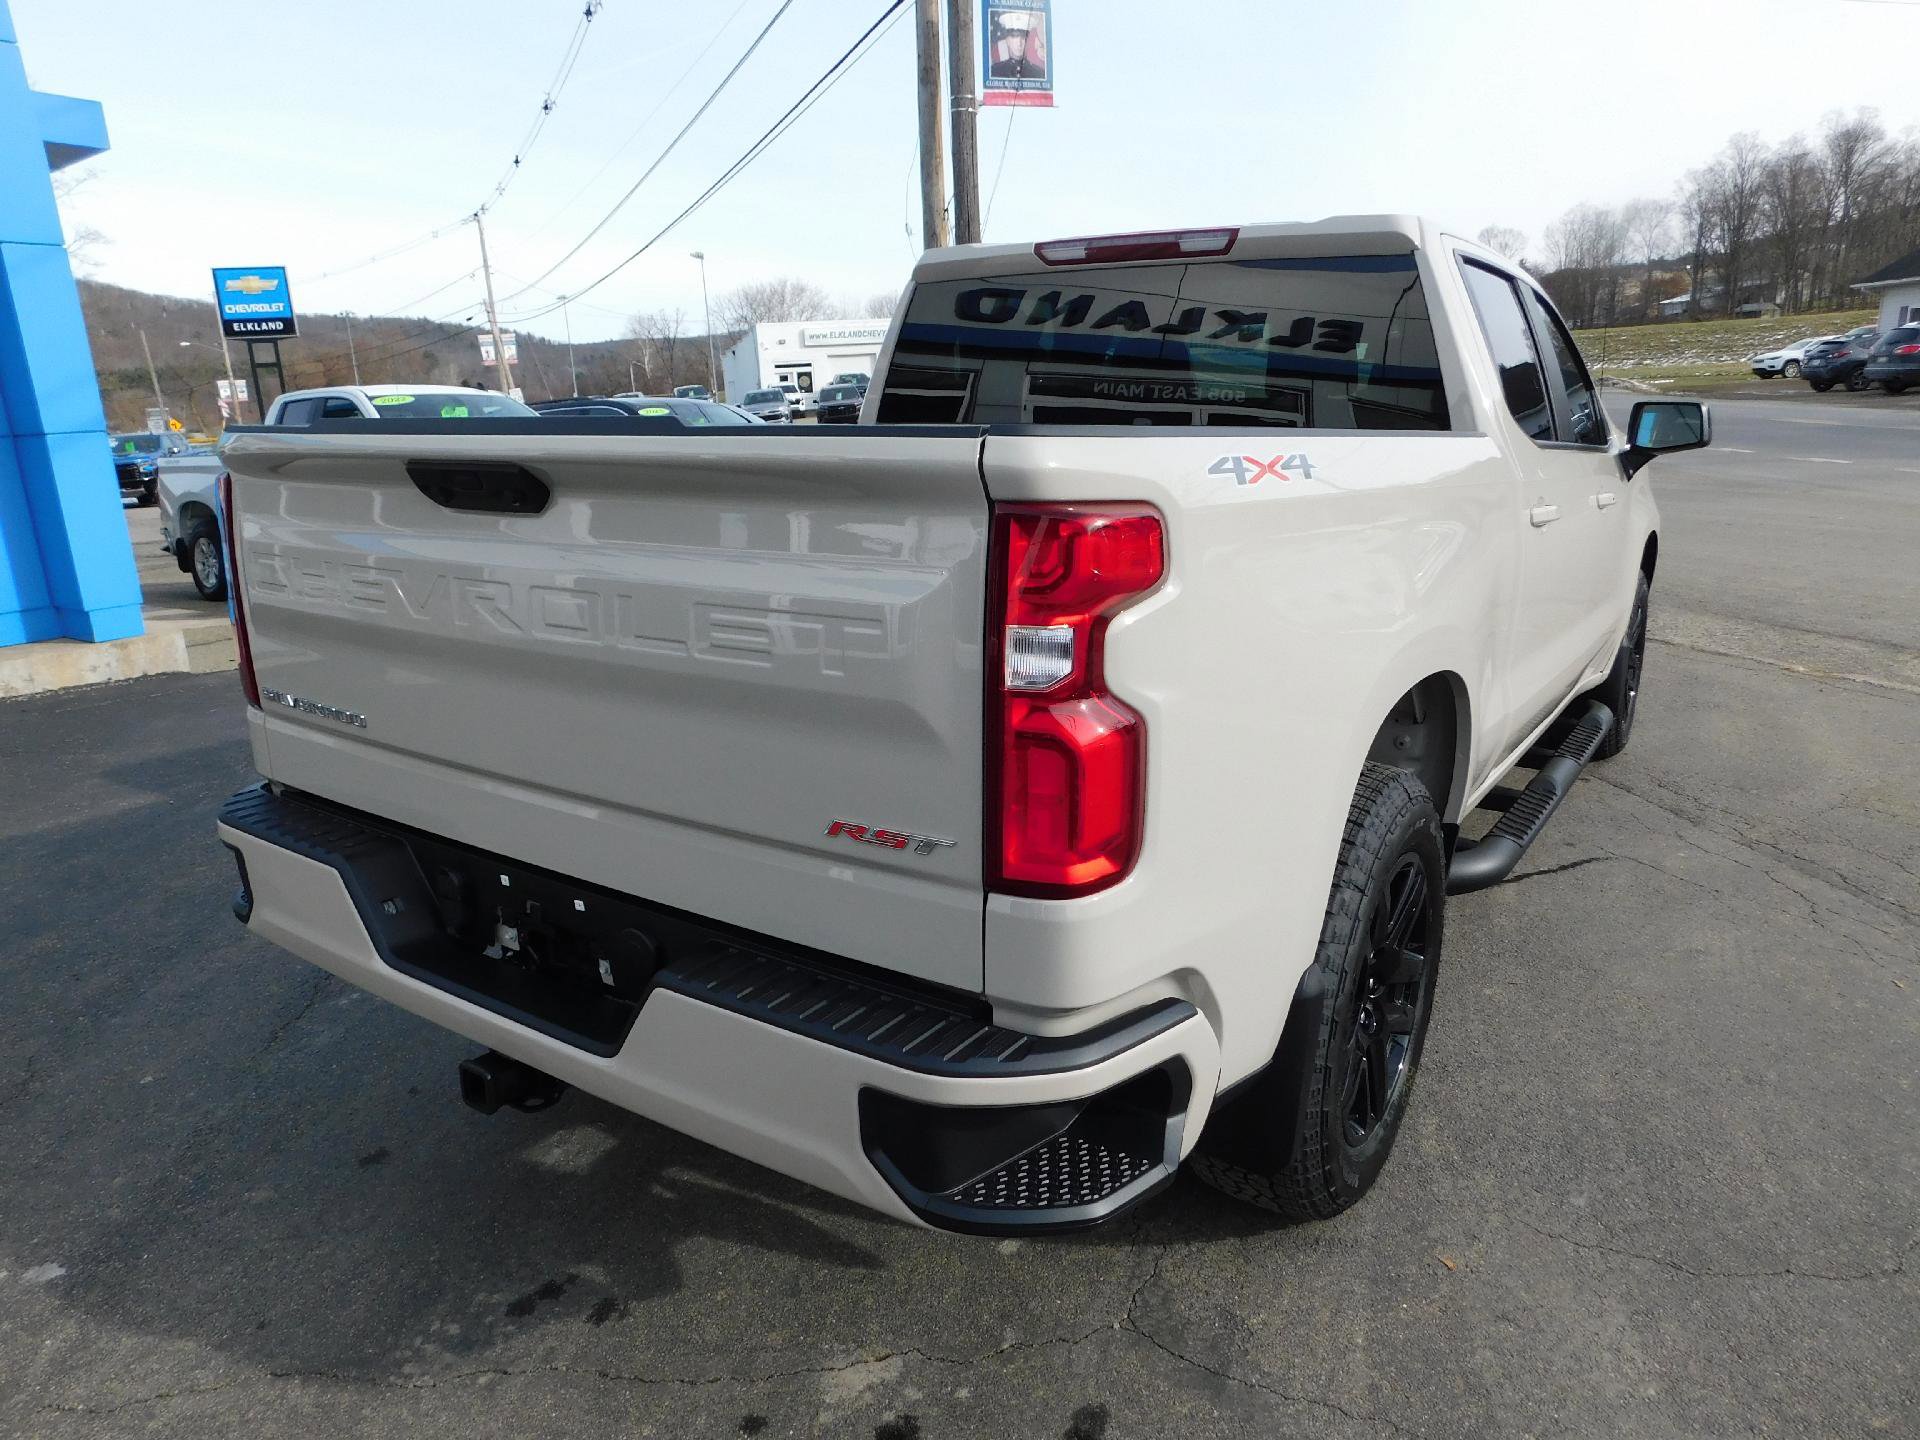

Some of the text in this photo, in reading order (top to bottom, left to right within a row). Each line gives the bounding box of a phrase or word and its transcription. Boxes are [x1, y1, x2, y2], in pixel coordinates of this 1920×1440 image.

[225, 303, 284, 313] CHEVROLET
[233, 322, 284, 331] ELKLAND
[250, 551, 884, 677] CHEVROLET
[824, 819, 957, 855] RST
